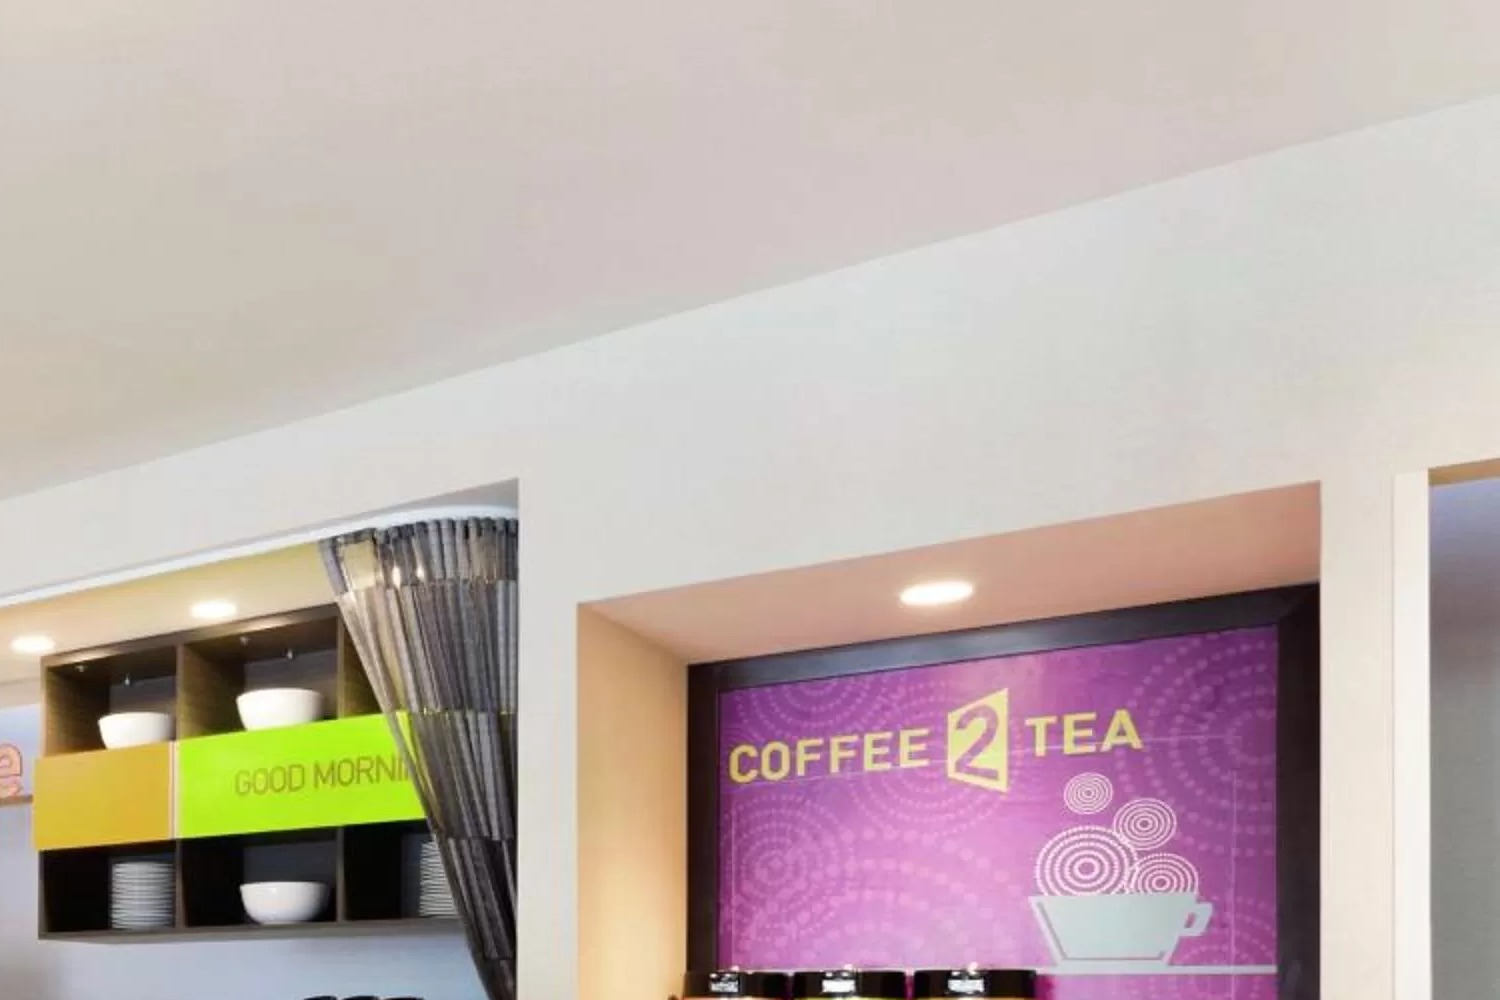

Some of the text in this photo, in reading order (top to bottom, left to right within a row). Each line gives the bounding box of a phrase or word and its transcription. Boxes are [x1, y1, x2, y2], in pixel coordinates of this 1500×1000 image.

[728, 702, 1143, 784] COFFEE 2 TEA
[235, 763, 305, 796] GOOD
